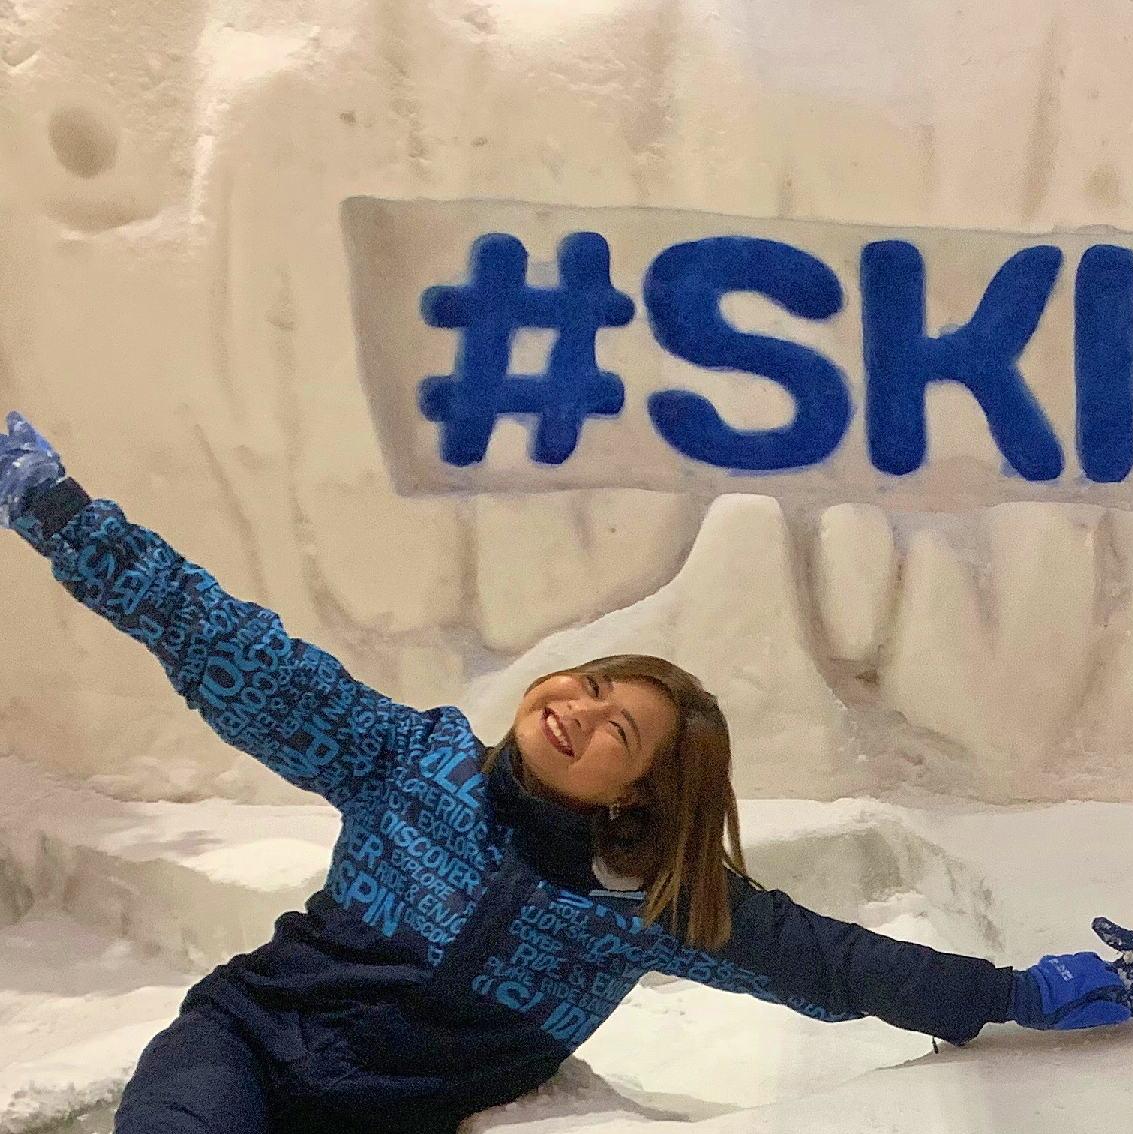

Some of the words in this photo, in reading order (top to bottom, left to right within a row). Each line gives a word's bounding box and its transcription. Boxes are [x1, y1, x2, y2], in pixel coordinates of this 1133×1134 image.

[378, 811, 482, 894] DISCOVER
[390, 849, 455, 901] EXPLORE
[327, 860, 411, 937] SPIN
